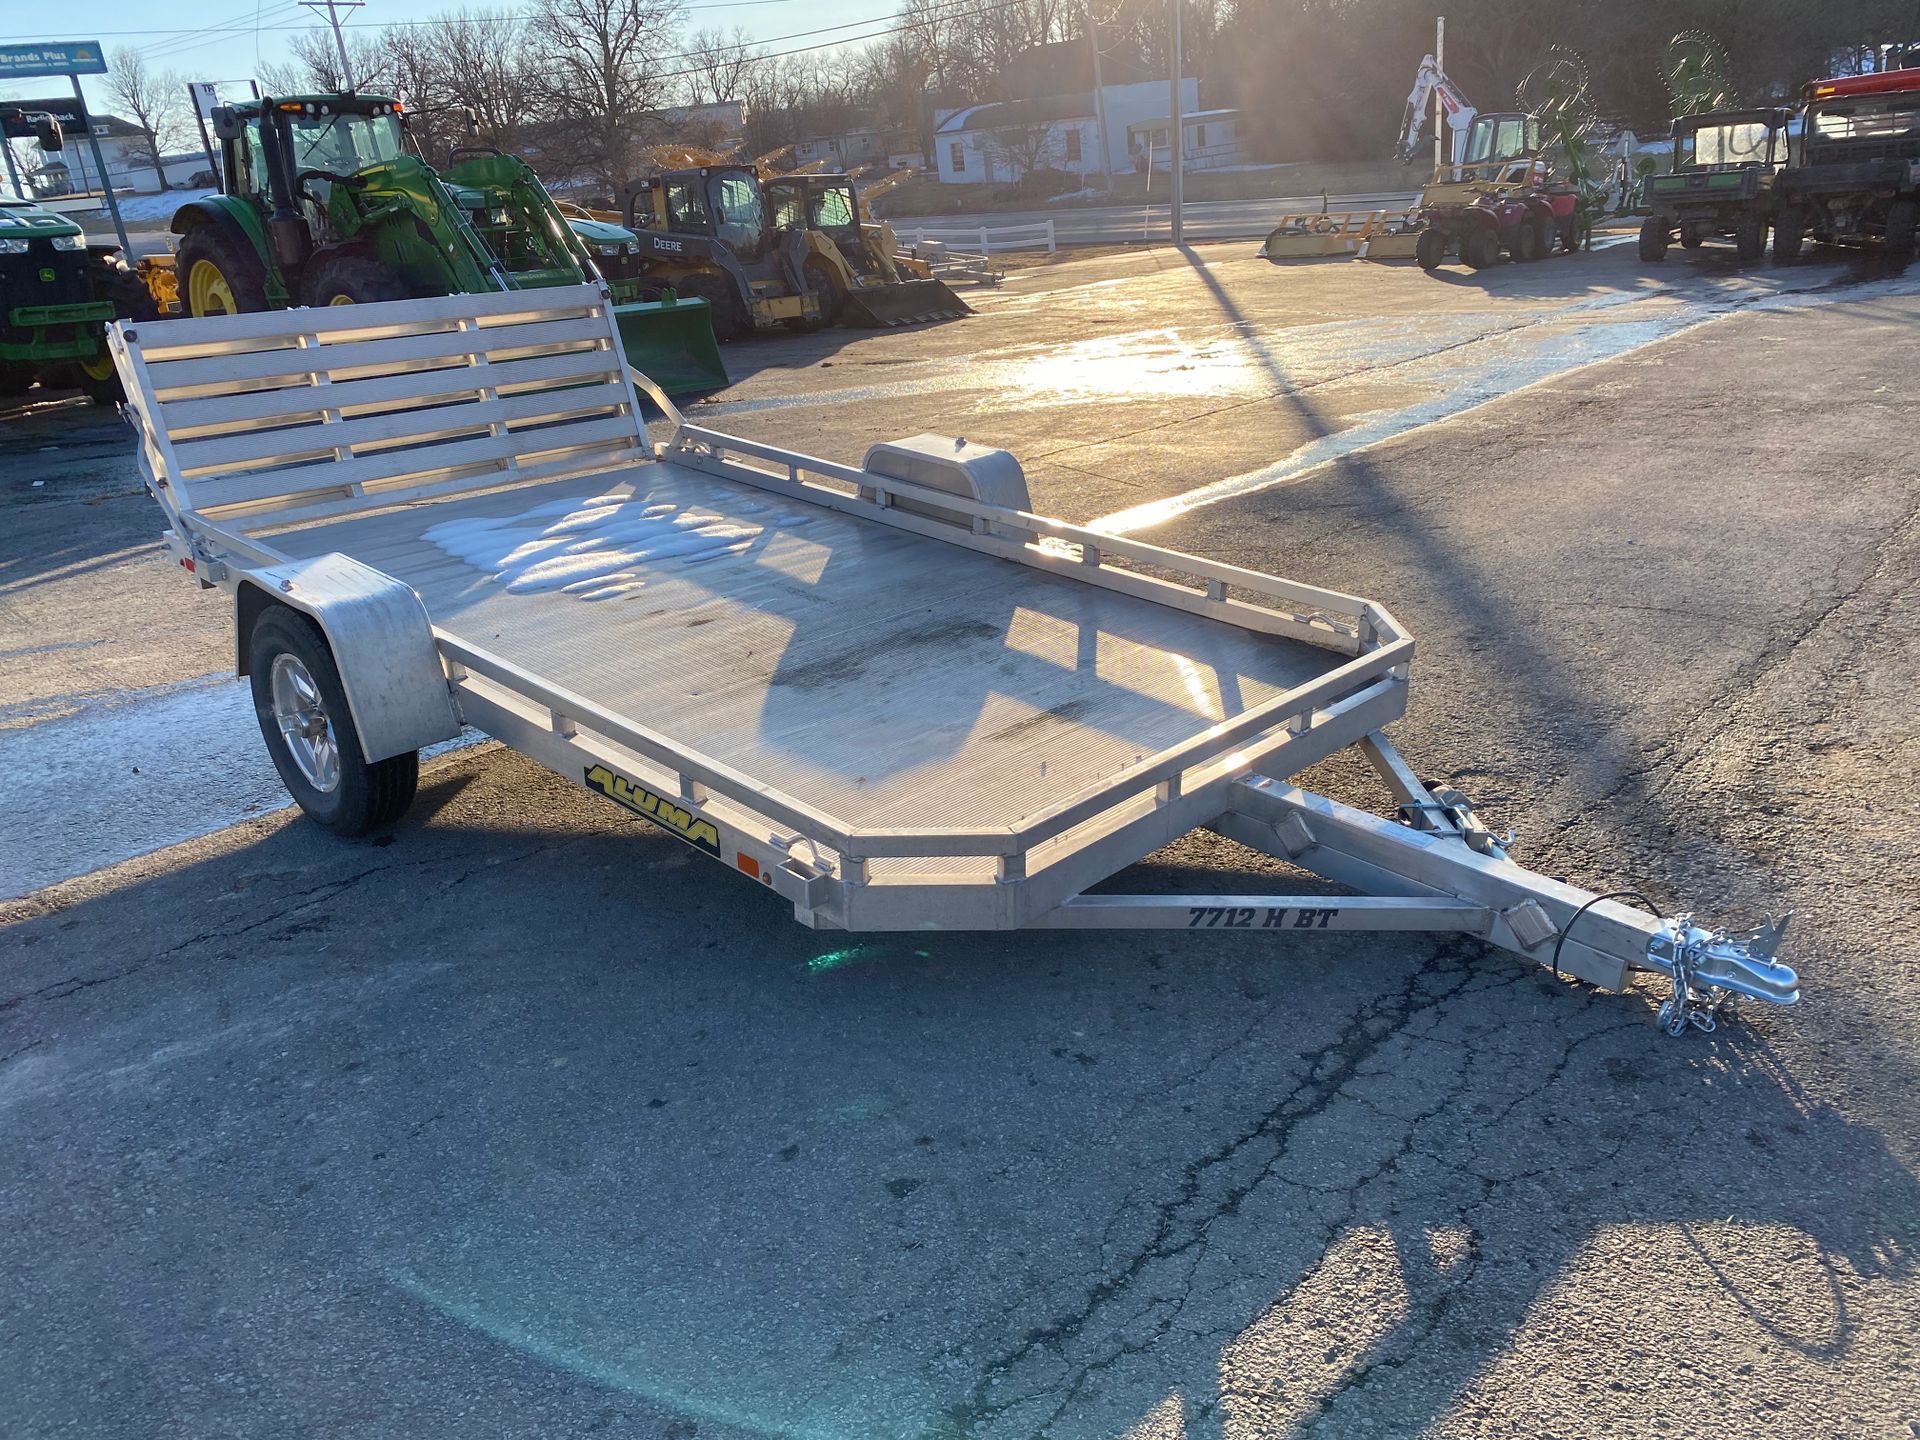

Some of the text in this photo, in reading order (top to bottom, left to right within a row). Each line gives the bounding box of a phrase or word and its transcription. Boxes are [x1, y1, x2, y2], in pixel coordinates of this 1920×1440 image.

[0, 53, 40, 63] Brands
[42, 51, 67, 61] Plus
[26, 112, 75, 123] Radiohack
[653, 236, 683, 252] DEERE
[584, 764, 720, 852] ALUMA
[1188, 907, 1339, 929] 7712 H BT
